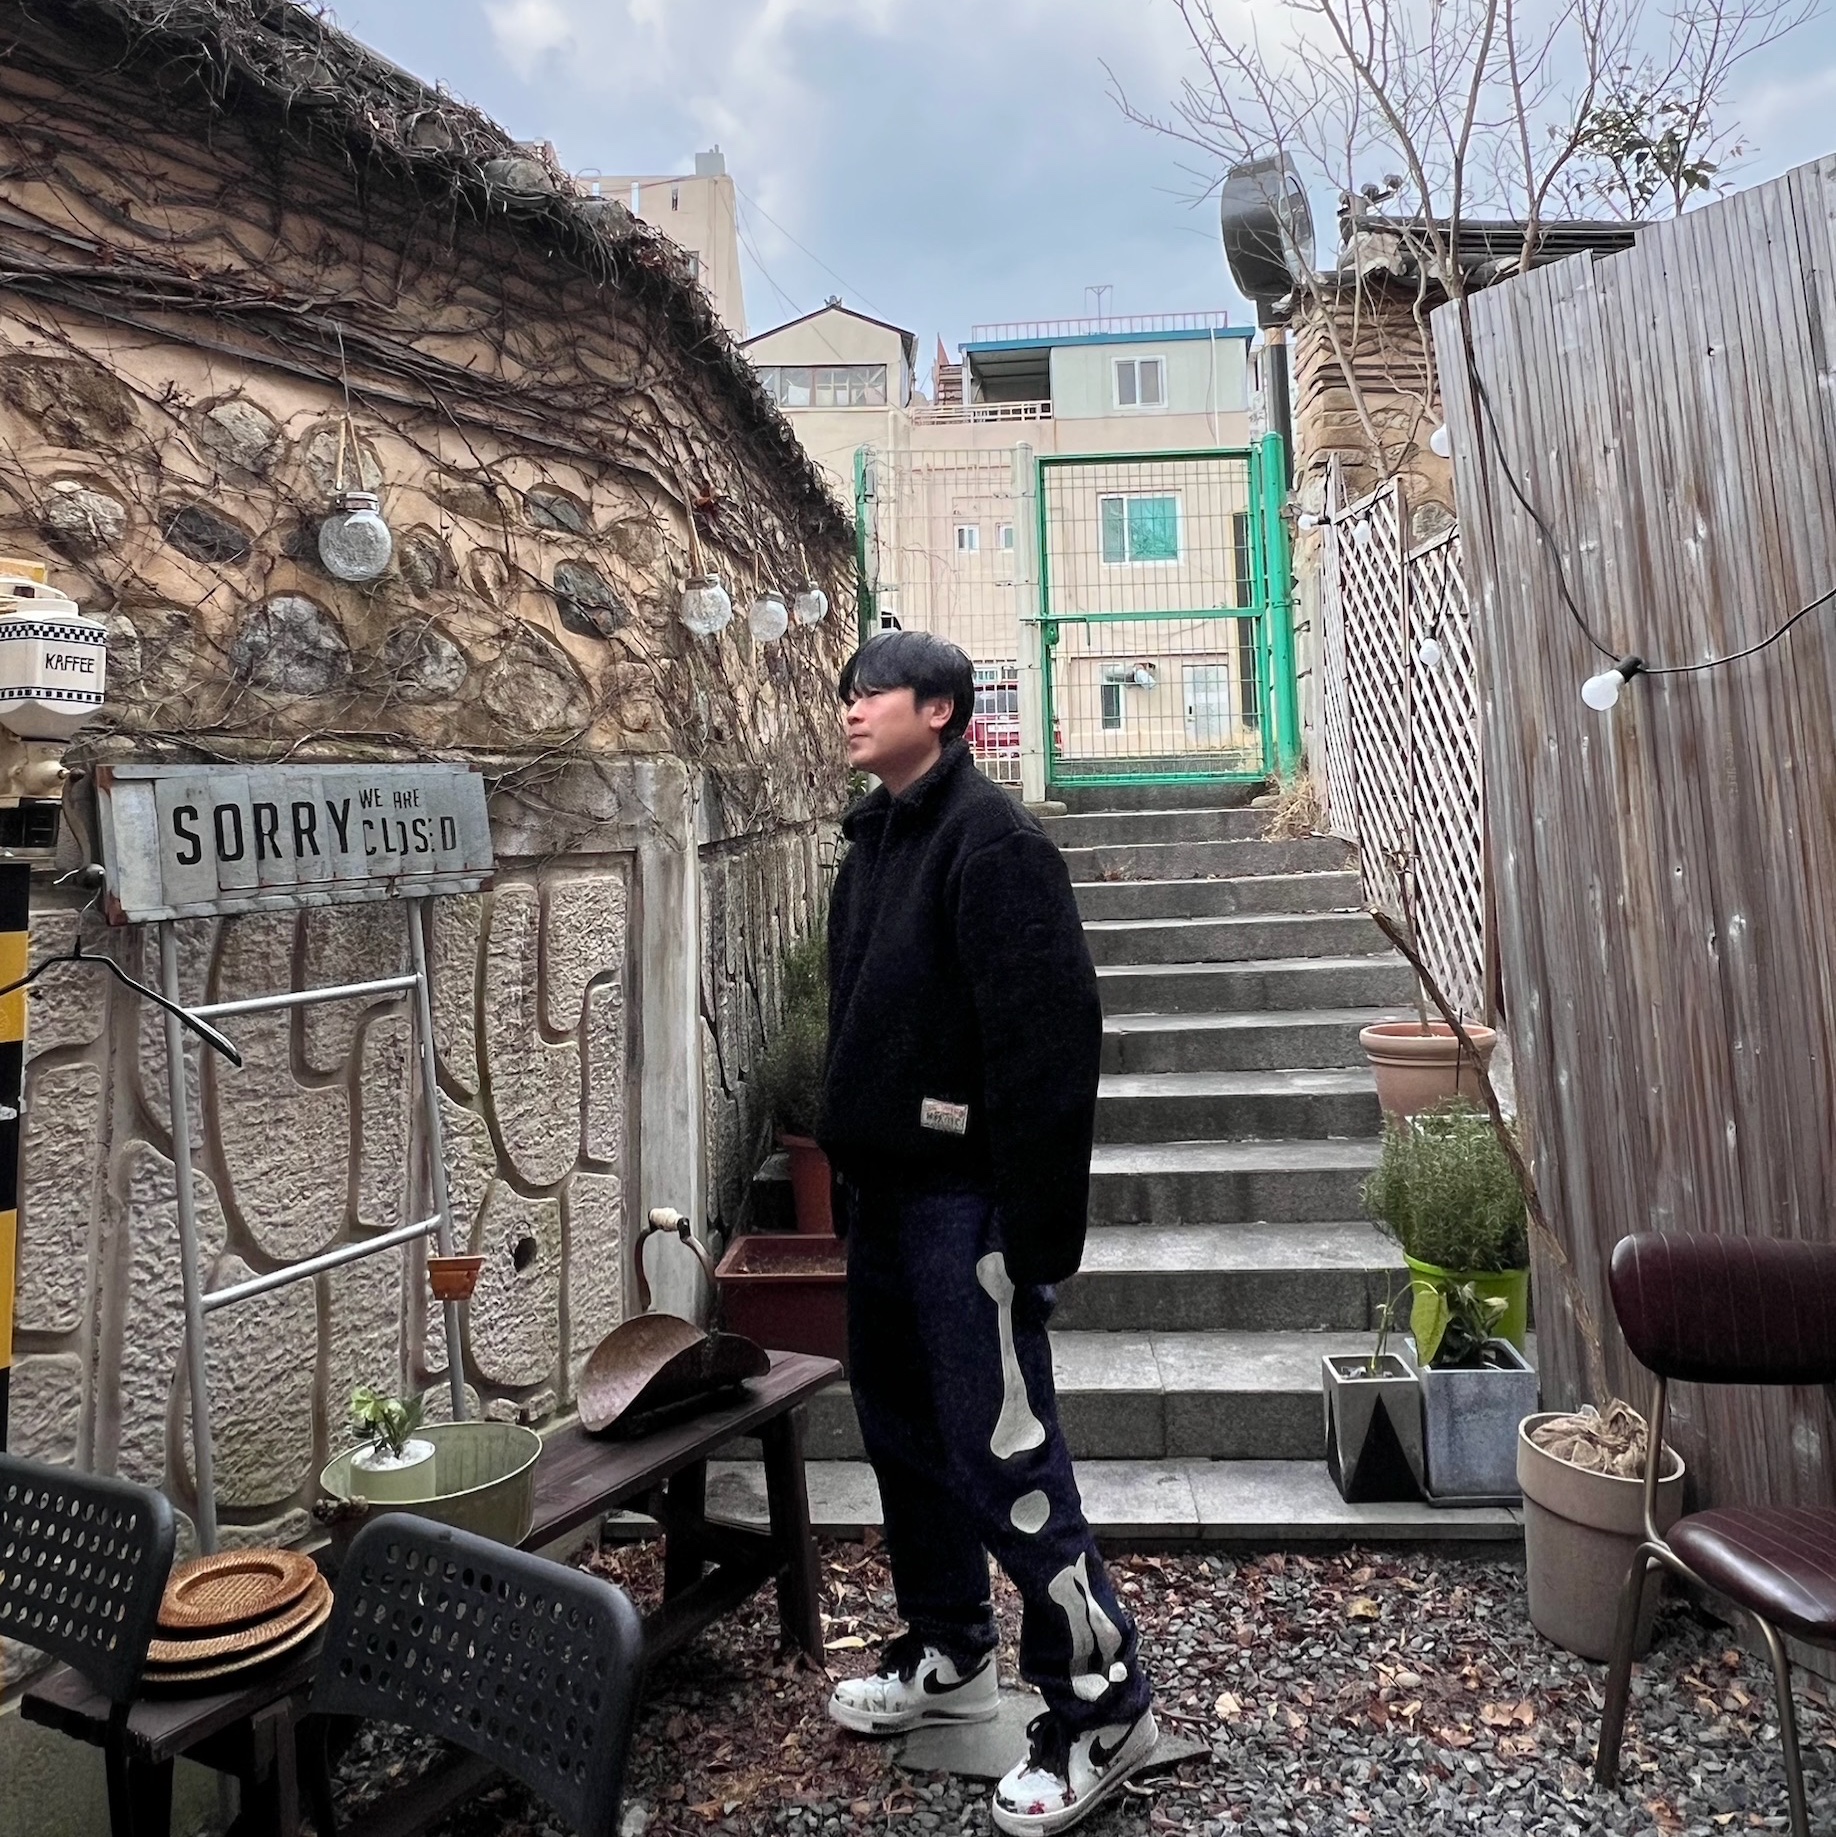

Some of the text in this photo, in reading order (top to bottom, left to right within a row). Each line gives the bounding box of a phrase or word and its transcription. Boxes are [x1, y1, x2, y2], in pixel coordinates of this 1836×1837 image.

[45, 653, 95, 673] KAFFEE
[359, 788, 420, 809] WE ARE
[173, 798, 351, 865] SORRY
[362, 816, 457, 856] CLOSD
